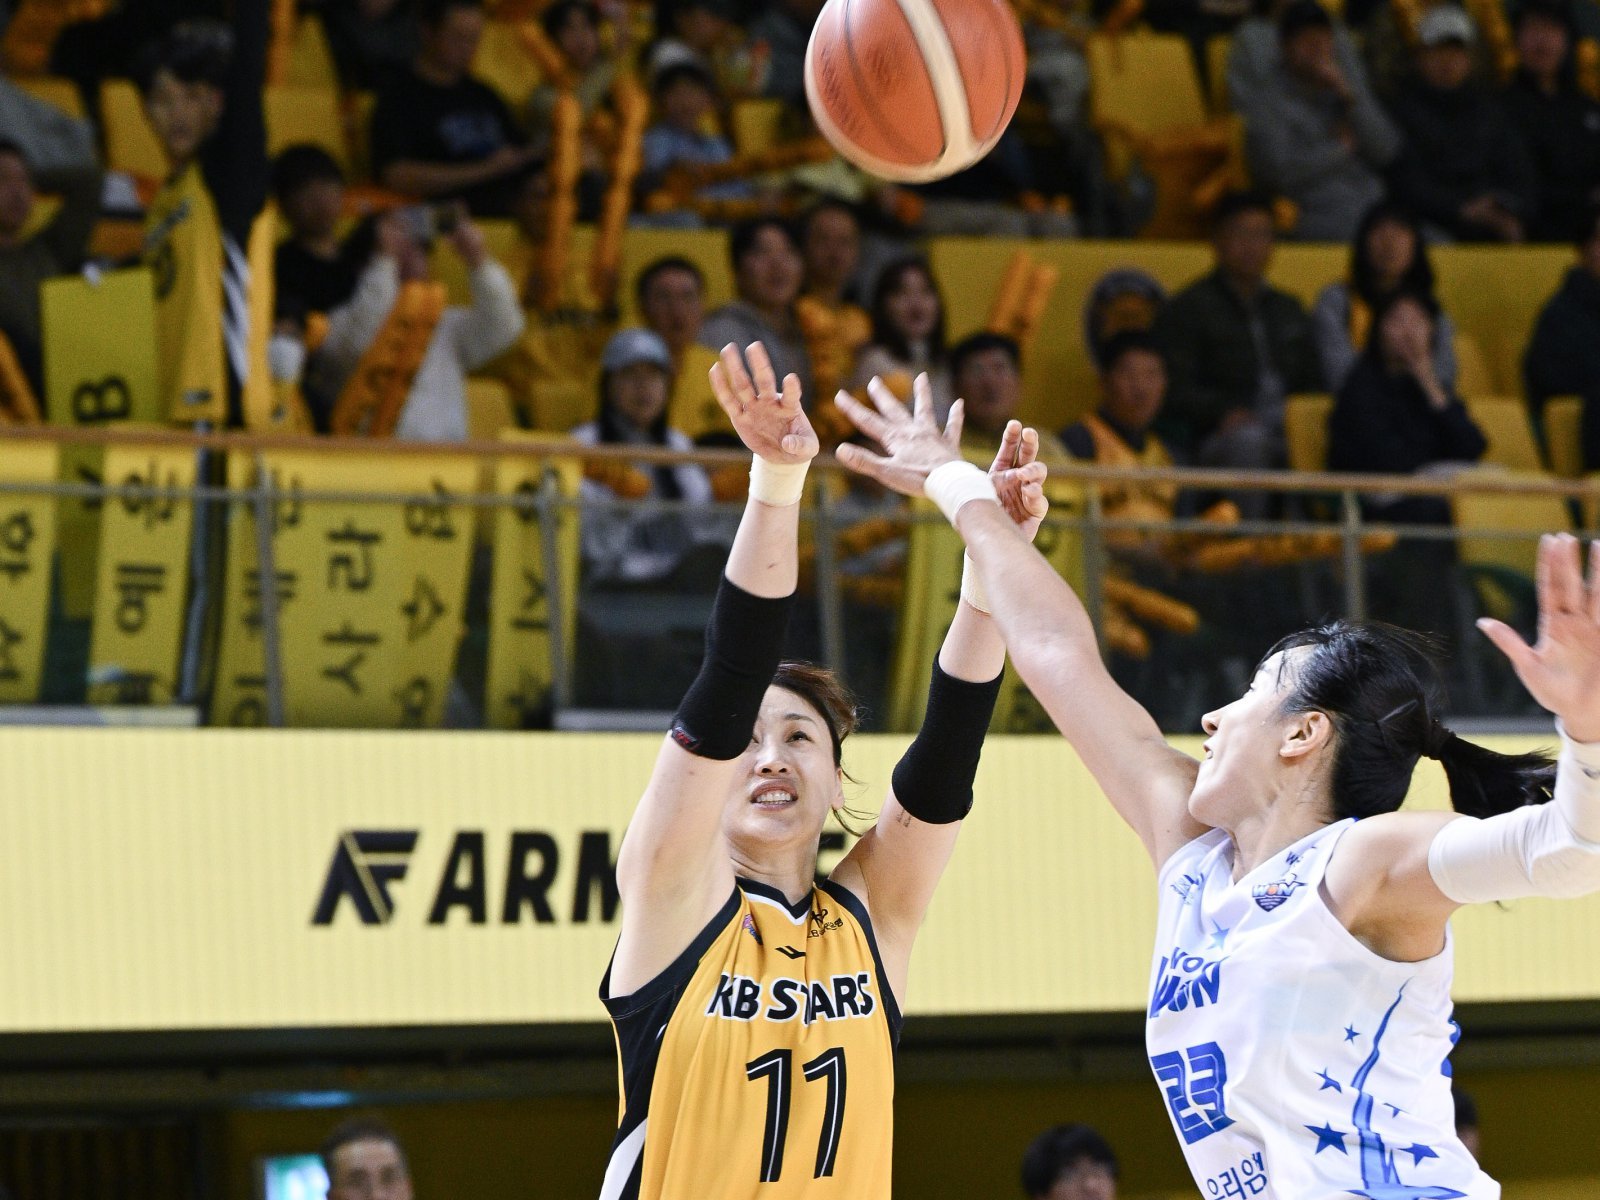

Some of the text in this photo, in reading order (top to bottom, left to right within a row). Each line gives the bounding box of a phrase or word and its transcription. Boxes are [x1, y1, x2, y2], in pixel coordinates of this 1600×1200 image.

[706, 972, 874, 1026] KB STARS
[746, 1046, 847, 1183] 11
[1150, 1041, 1237, 1145] 23
